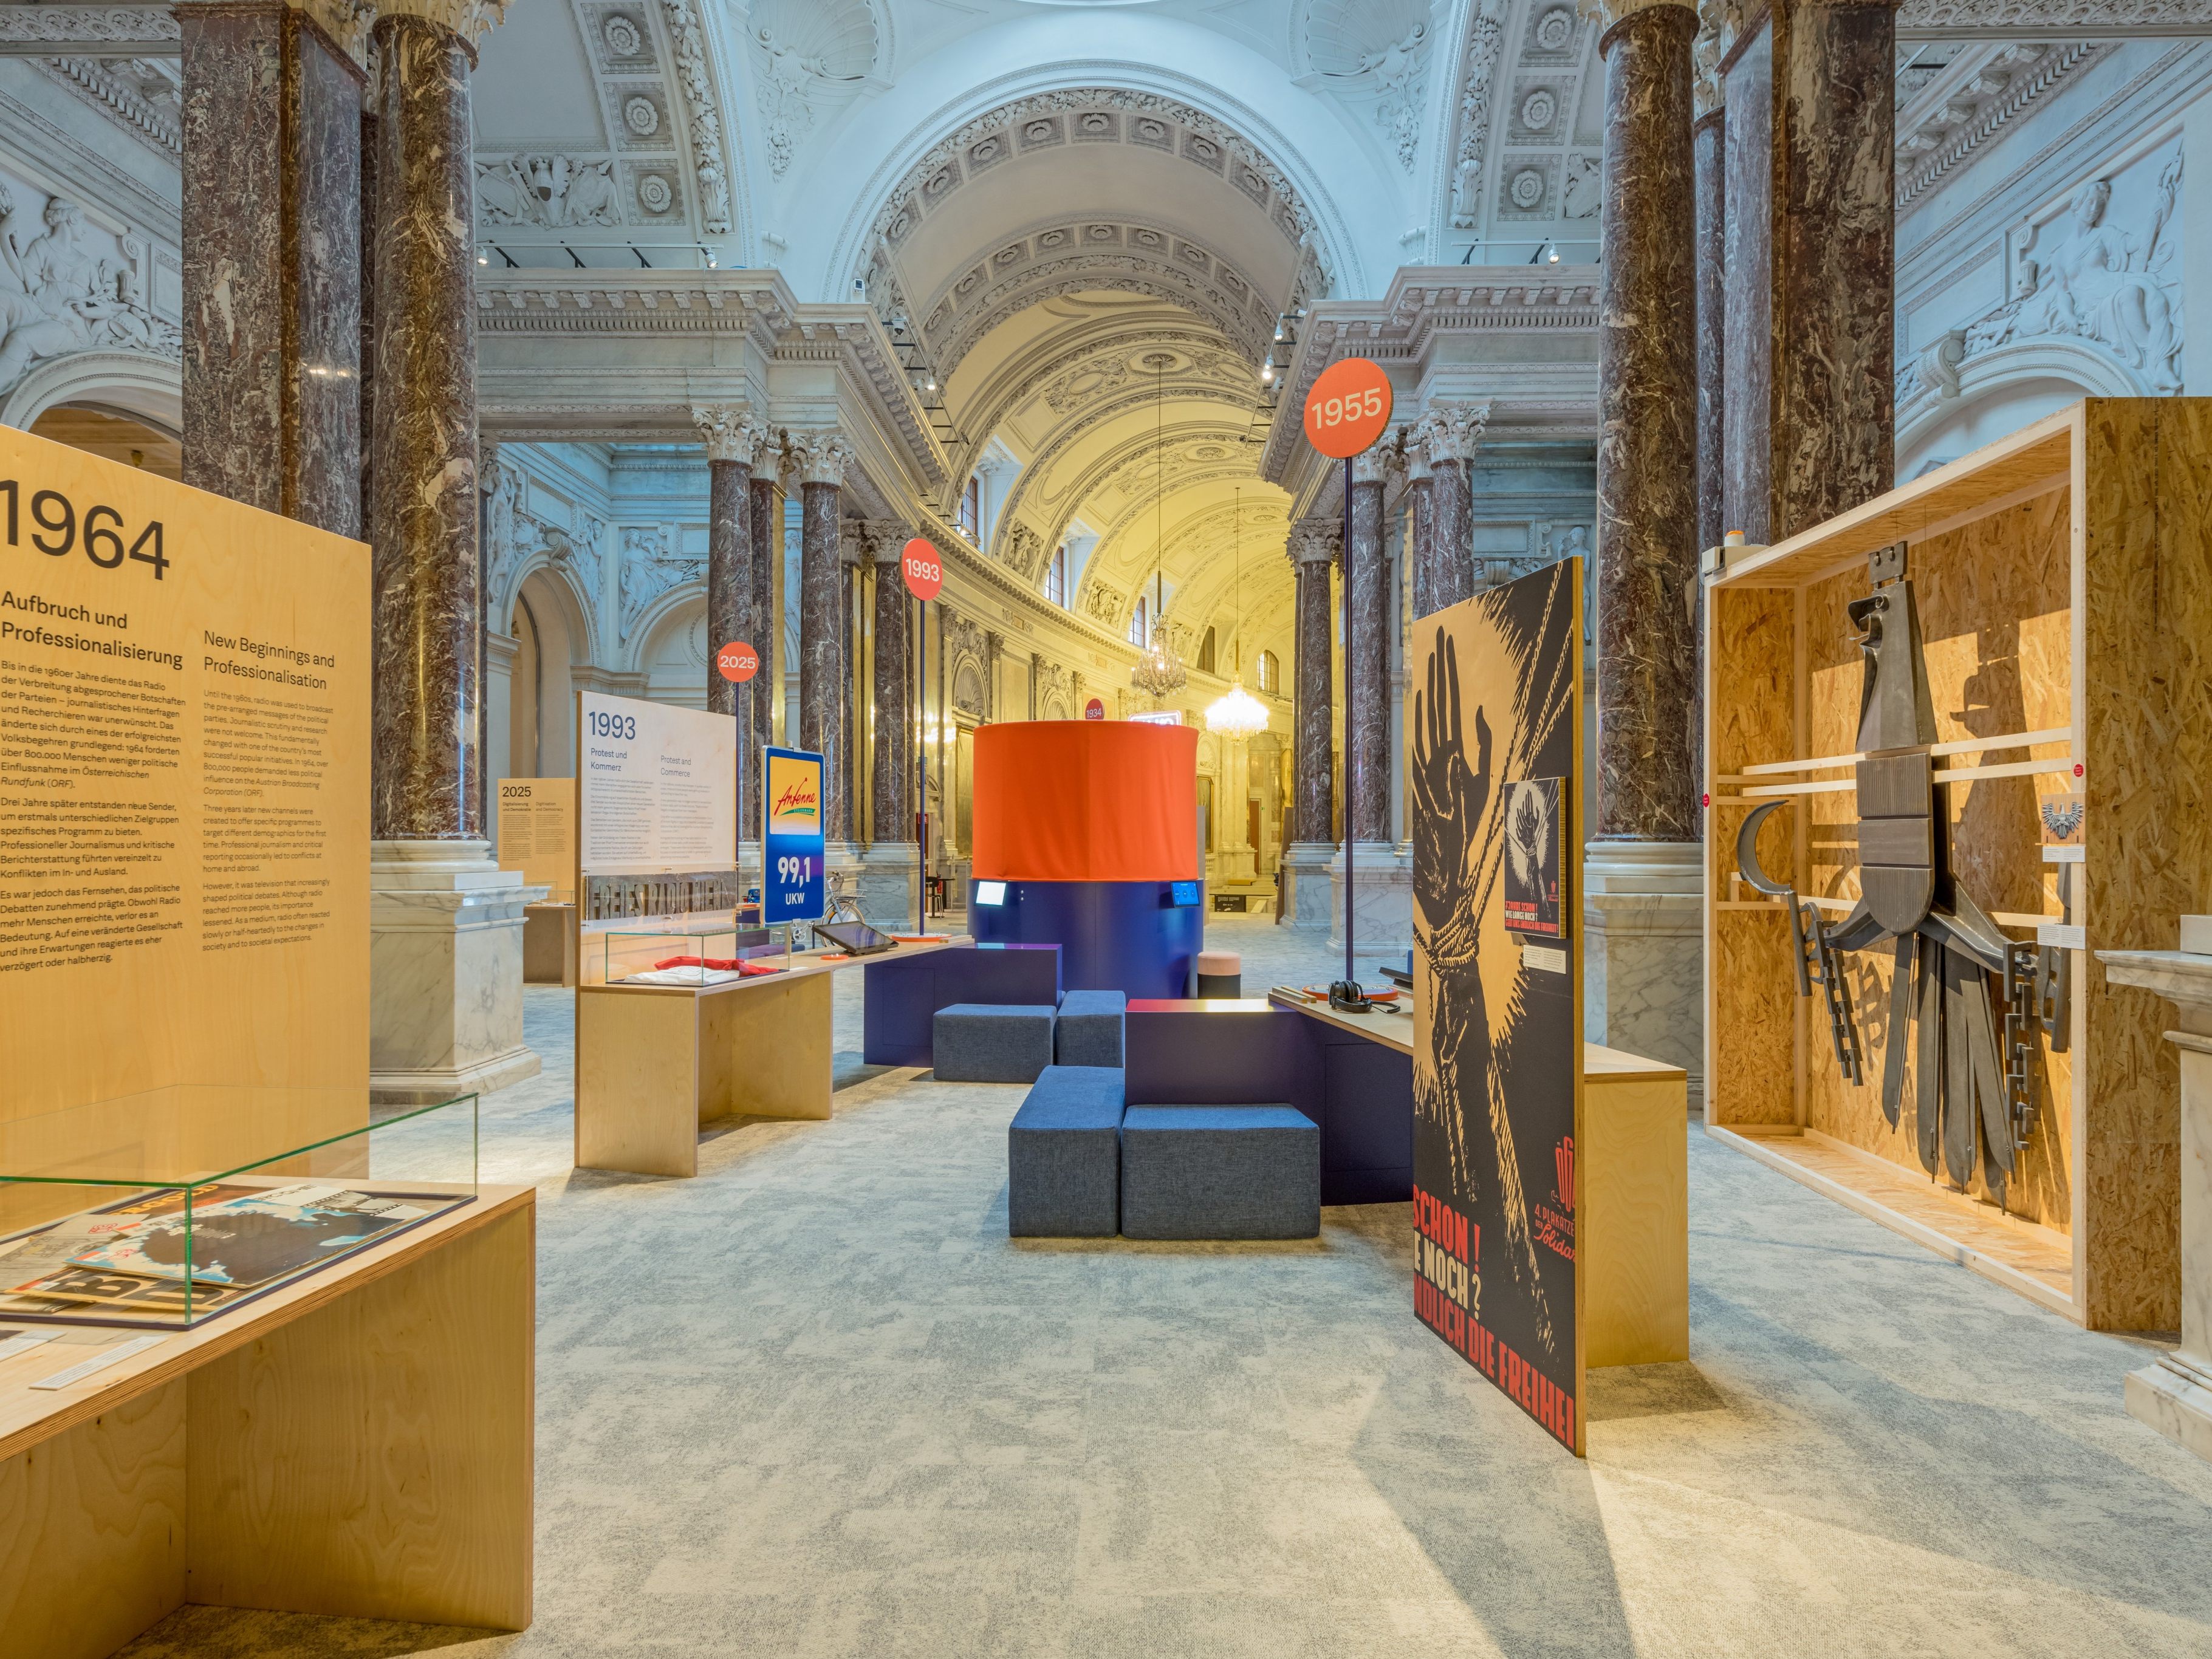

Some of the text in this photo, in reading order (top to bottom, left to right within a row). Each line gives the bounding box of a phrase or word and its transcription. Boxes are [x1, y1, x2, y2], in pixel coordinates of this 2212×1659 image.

[1312, 388, 1382, 429] 1955
[0, 479, 169, 581] 1964
[906, 558, 940, 582] 1993
[1, 590, 128, 629] Aufbruch und
[1, 621, 183, 669] Professionalisierung
[204, 630, 335, 668] New Beginnings and
[721, 655, 756, 669] 2025
[2, 661, 16, 670] Bis
[18, 663, 26, 671] in
[29, 665, 43, 674] die
[44, 668, 74, 677] 1960er
[75, 671, 99, 682] Jahre
[101, 675, 126, 685] diente
[144, 681, 165, 691] Radio
[204, 657, 327, 690] Professionalisation
[1, 676, 185, 705] der Verbreitung abgesprochener Botschaften
[1, 690, 17, 699] der
[19, 692, 56, 703] Parteien
[66, 697, 131, 712] journalistisches
[133, 706, 180, 719] Hinterfragen
[1086, 708, 1101, 719] 1934
[22, 706, 86, 720] Recherchieren
[105, 717, 158, 728] unerwünscht.
[589, 711, 636, 740] 1993
[1, 719, 38, 730] änderte
[39, 723, 58, 731] sich
[60, 725, 84, 734] durch
[86, 727, 108, 736] eines
[125, 731, 181, 742] erfolgreichsten
[1, 733, 180, 755] Volksbegehren grundlegend: 1964 forderten
[1, 748, 178, 767] über 800.000 Menschen weniger politische
[591, 748, 627, 759] Protest und
[660, 755, 680, 765] Protest
[1, 762, 67, 774] Einflussnahme
[82, 766, 149, 778] Österreichischen
[591, 761, 621, 771] Kommerz
[660, 768, 690, 778] Commerce
[1, 777, 75, 788] Rundfunk (ORF).
[502, 786, 532, 797] 2025
[22, 798, 48, 807] Jahre
[50, 799, 78, 809] später
[149, 802, 176, 811] Sender,
[773, 777, 816, 816] Antenne
[134, 815, 179, 825] Zielgruppen
[1, 827, 56, 836] spezifisches
[59, 827, 103, 837] Programm
[1, 841, 67, 849] Professioneller
[1, 855, 80, 864] Berichterstattung
[1, 869, 47, 878] Konflikten
[778, 857, 810, 888] 99,1
[1, 891, 11, 899] Es
[32, 889, 63, 900] jedoch
[82, 886, 127, 895] Fernsehen,
[144, 884, 180, 894] politische
[591, 884, 645, 919] FREIES
[648, 881, 690, 916] RADIO
[786, 892, 804, 905] UKW
[0, 905, 43, 913] Debatten
[46, 901, 96, 911] zunehmend
[98, 900, 126, 910] prägte.
[128, 898, 157, 906] Obwohl
[1521, 902, 1535, 912] SCHON
[0, 919, 24, 928] mehr
[27, 917, 73, 926] Menschen
[75, 914, 114, 923] erreichte,
[1513, 911, 1524, 920] LANGE
[1524, 912, 1535, 922] NOCH
[0, 933, 53, 942] Bedeutung.
[54, 929, 69, 938] Auf
[91, 926, 134, 935] veränderte
[136, 922, 183, 931] Gesellschaft
[0, 948, 18, 957] und
[39, 943, 95, 953] Erwartungen
[97, 939, 133, 949] reagierte
[0, 954, 112, 971] verzögert oder halbherzig.
[1414, 1184, 1468, 1264] SCHON
[1424, 1237, 1468, 1310] NOCH
[1472, 1273, 1481, 1320] ?
[1468, 1316, 1494, 1379] DIE
[1499, 1340, 1574, 1449] FREIHEI
